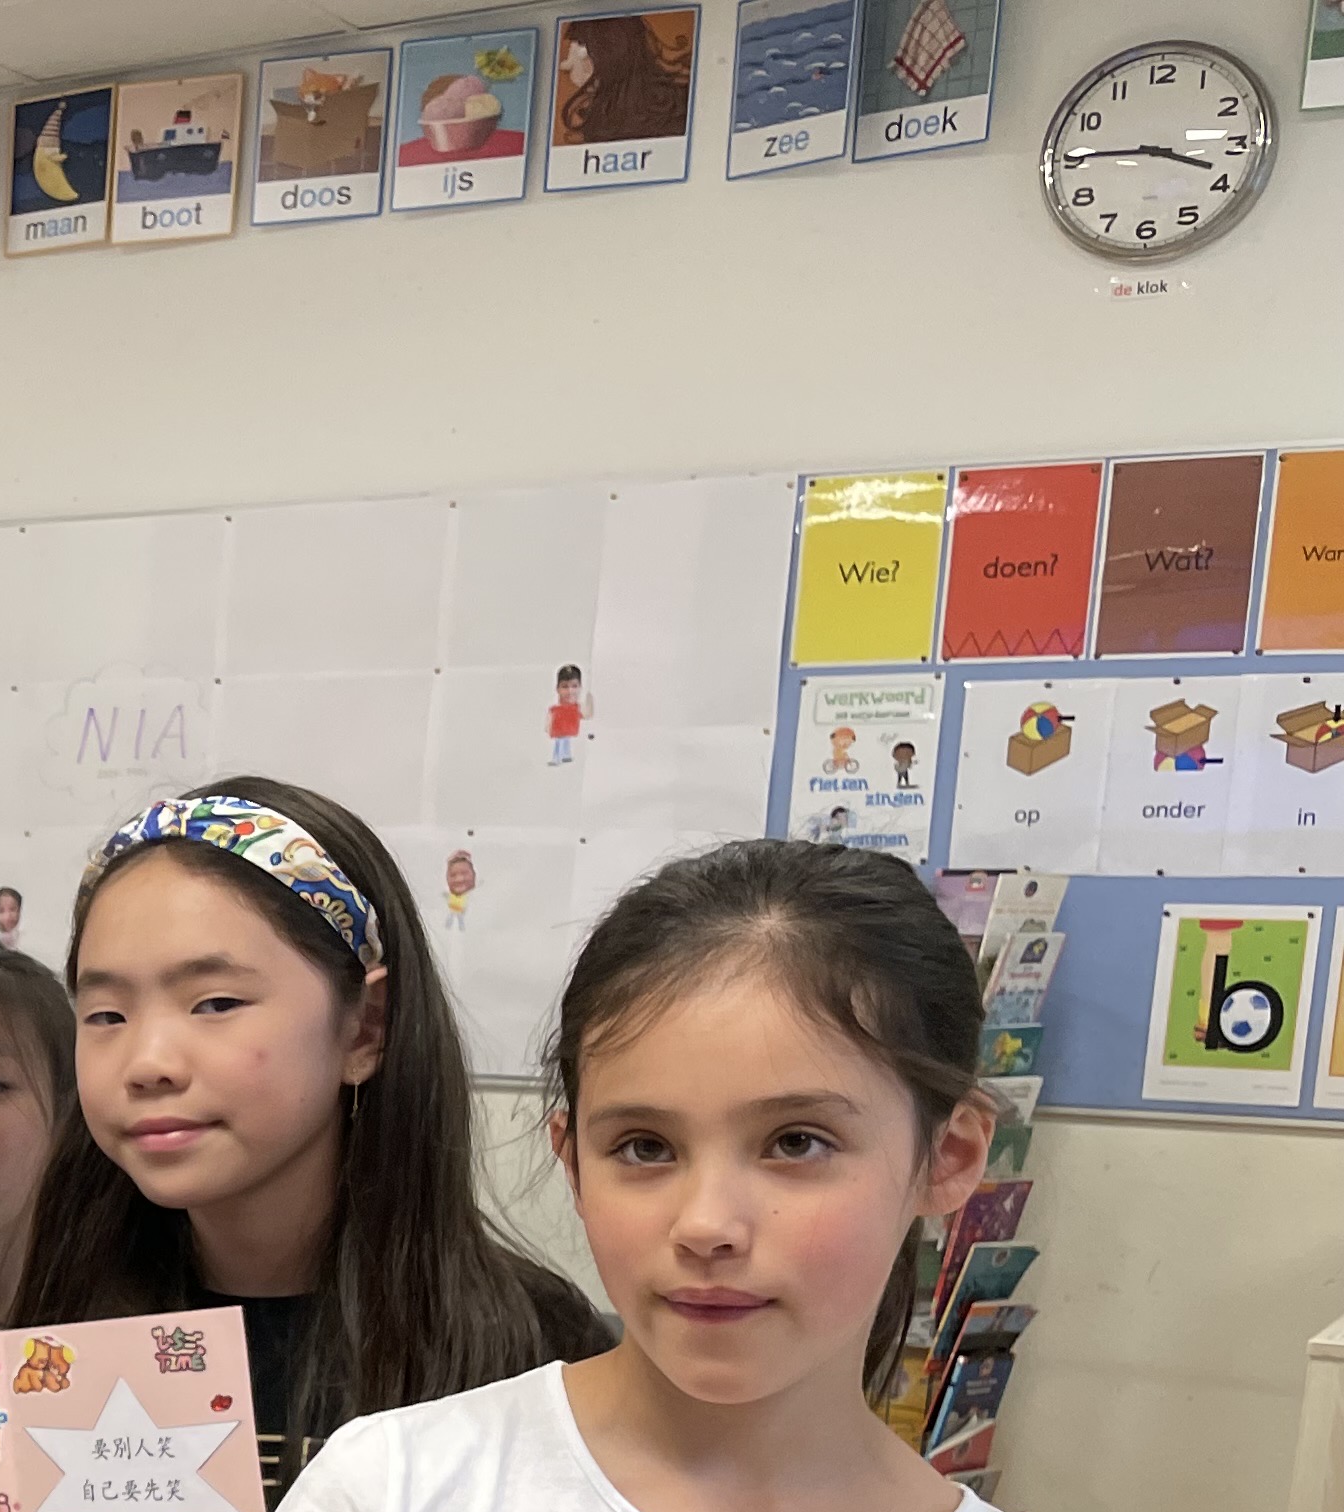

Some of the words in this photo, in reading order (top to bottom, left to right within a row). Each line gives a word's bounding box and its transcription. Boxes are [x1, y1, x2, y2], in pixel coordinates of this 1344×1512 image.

[1148, 64, 1174, 85] 12
[1198, 69, 1207, 89] 1
[1111, 81, 1127, 101] 11
[1216, 97, 1239, 117] 2
[884, 106, 958, 143] doek
[1080, 111, 1101, 132] 10
[763, 127, 810, 158] zee
[1224, 136, 1247, 156] 3
[583, 148, 653, 176] haar
[1063, 153, 1084, 169] 9
[441, 169, 474, 199] ijs
[1209, 174, 1230, 193] 4
[281, 182, 353, 211] doos
[1072, 187, 1094, 207] 8
[141, 202, 202, 230] boot
[1099, 213, 1118, 234] 7
[1176, 205, 1199, 226] 5
[25, 211, 87, 242] maan
[1135, 220, 1157, 240] 6
[1113, 282, 1132, 298] de
[1136, 279, 1168, 296] klok
[983, 554, 1059, 581] doen?
[1144, 548, 1212, 574] Wat?
[839, 560, 900, 585] Wie?
[77, 704, 187, 764] NIA
[1014, 805, 1040, 828] op
[1142, 801, 1205, 820] onder
[1296, 807, 1316, 826] in
[92, 1436, 176, 1461] 要別人笑
[82, 1478, 186, 1502] 自己要先笑
